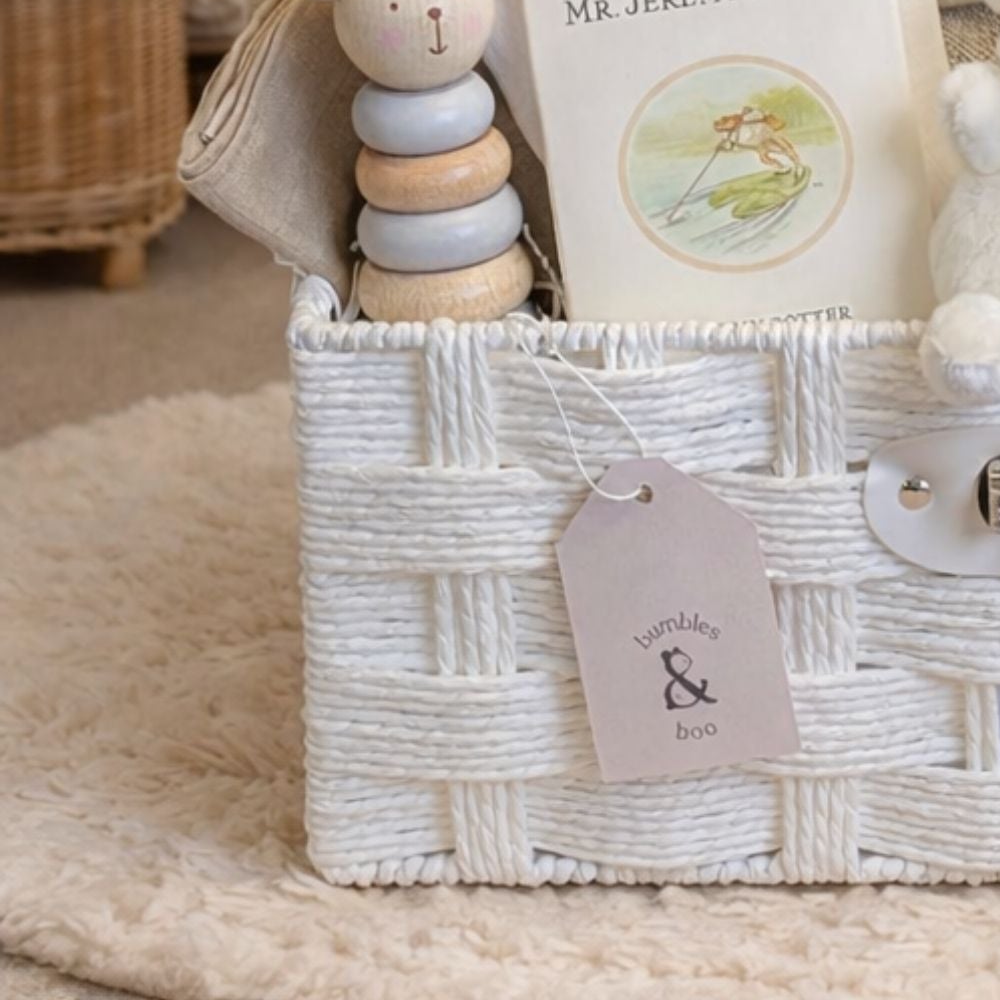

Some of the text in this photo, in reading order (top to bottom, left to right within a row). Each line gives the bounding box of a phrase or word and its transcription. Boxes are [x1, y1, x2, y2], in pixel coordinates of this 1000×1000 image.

[633, 611, 721, 650] bumbles
[660, 646, 718, 711] &
[675, 721, 718, 741] boo
